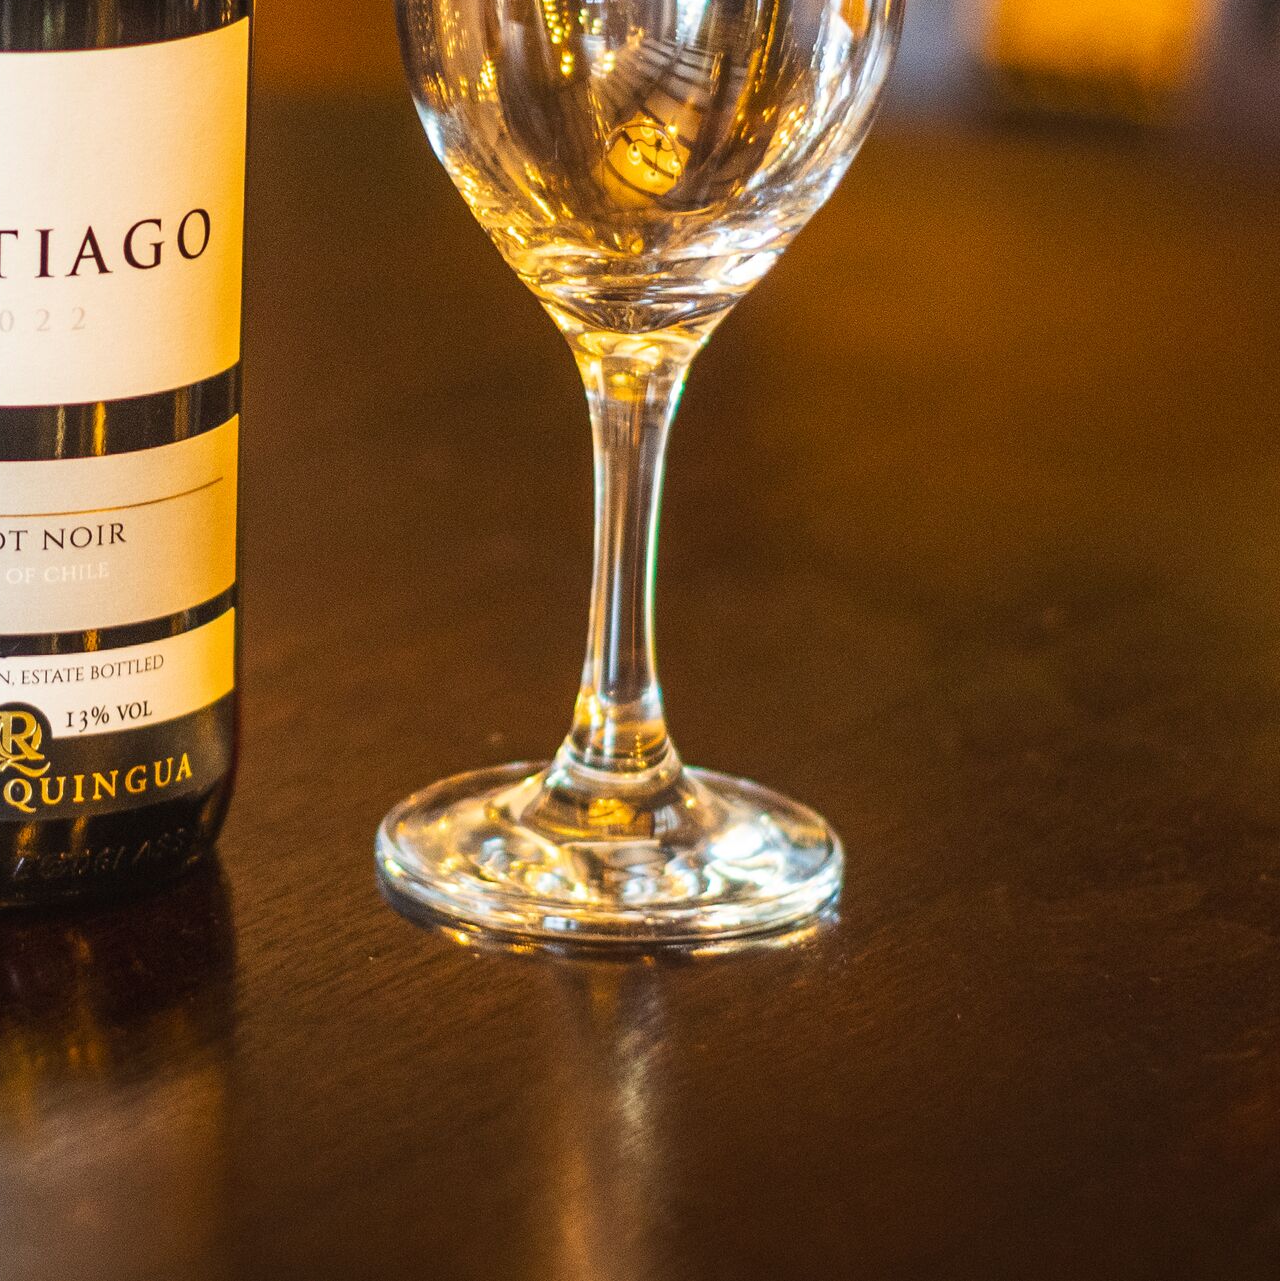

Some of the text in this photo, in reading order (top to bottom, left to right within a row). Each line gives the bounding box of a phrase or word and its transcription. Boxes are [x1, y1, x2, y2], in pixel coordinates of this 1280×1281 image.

[42, 522, 126, 551] NOIR
[6, 566, 36, 585] OF
[43, 561, 111, 583] CHILE
[21, 666, 85, 685] ESTATE
[90, 654, 165, 680] BOTTLED
[65, 700, 153, 733] 13% VOL
